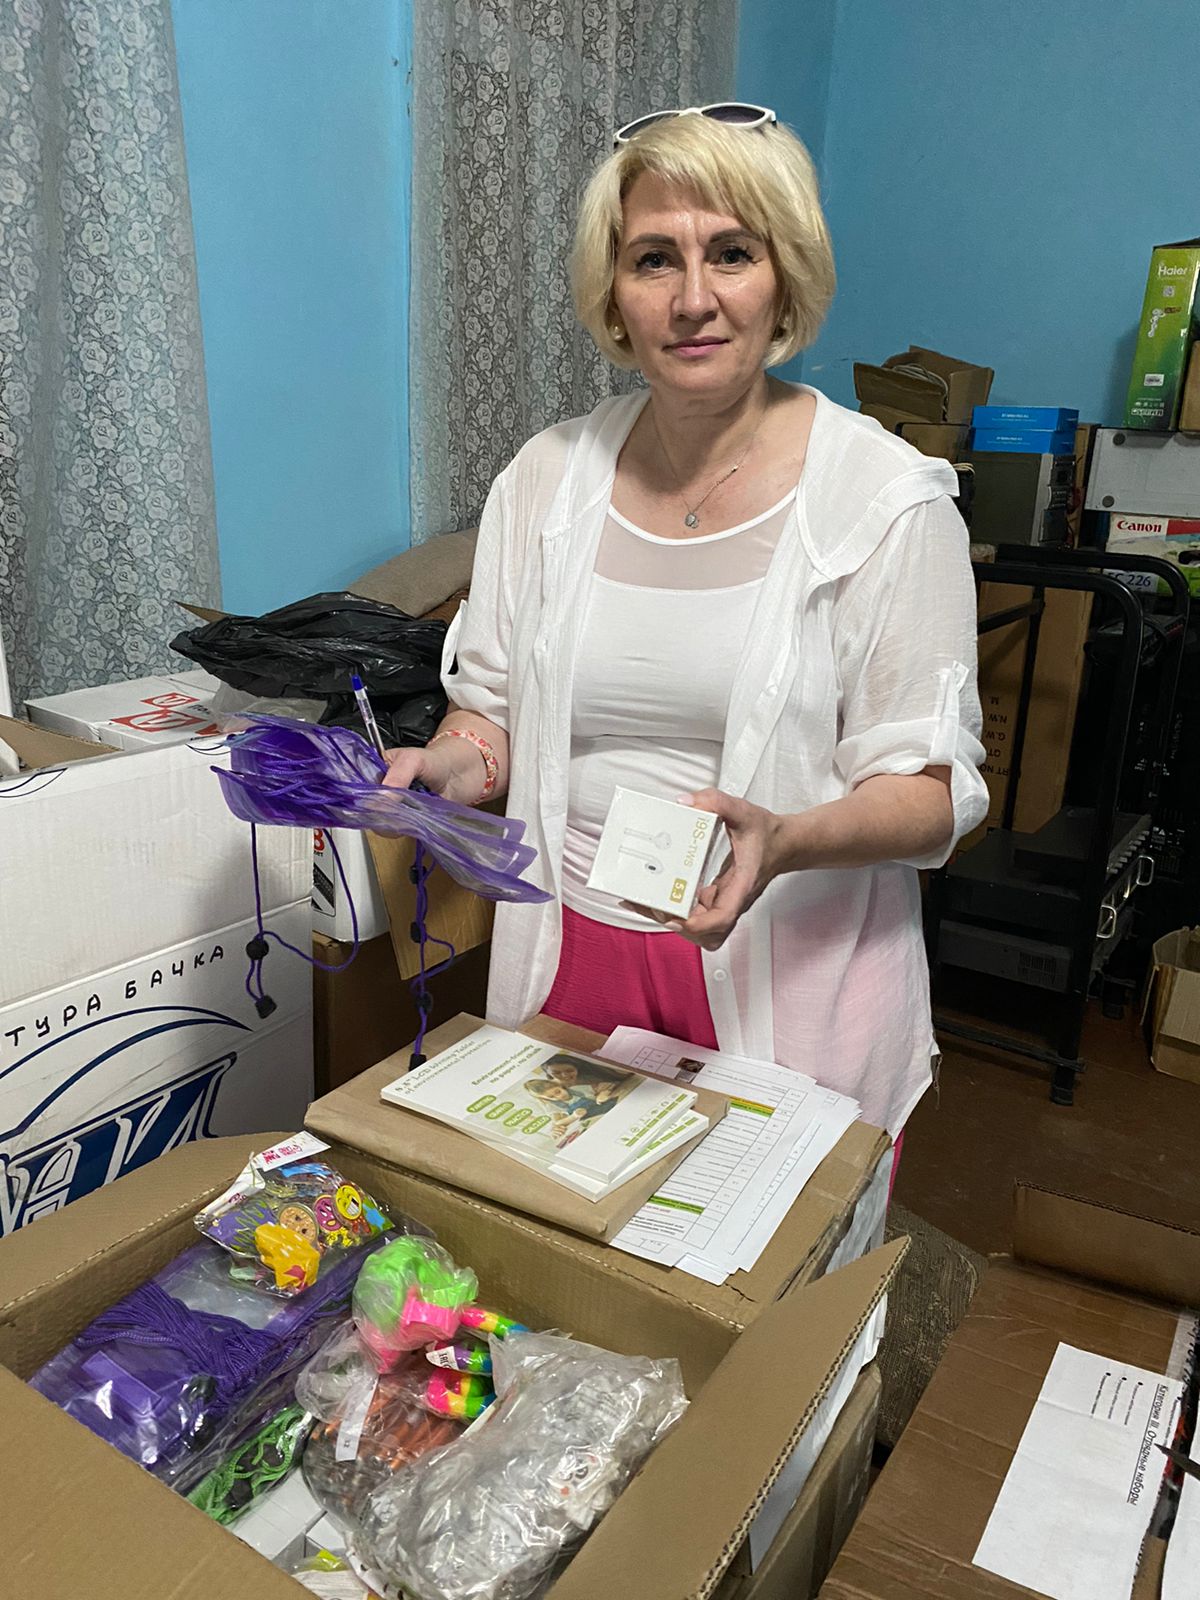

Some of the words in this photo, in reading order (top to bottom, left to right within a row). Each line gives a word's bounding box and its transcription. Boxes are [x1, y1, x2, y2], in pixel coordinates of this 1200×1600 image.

[1158, 263, 1187, 276] Haier
[1117, 520, 1162, 533] Canon
[1126, 574, 1151, 587] 226
[124, 945, 225, 1000] БАЧКА
[1151, 1384, 1169, 1420] Категория
[1138, 1429, 1157, 1472] Отрядные
[1129, 1472, 1145, 1506] наборы
